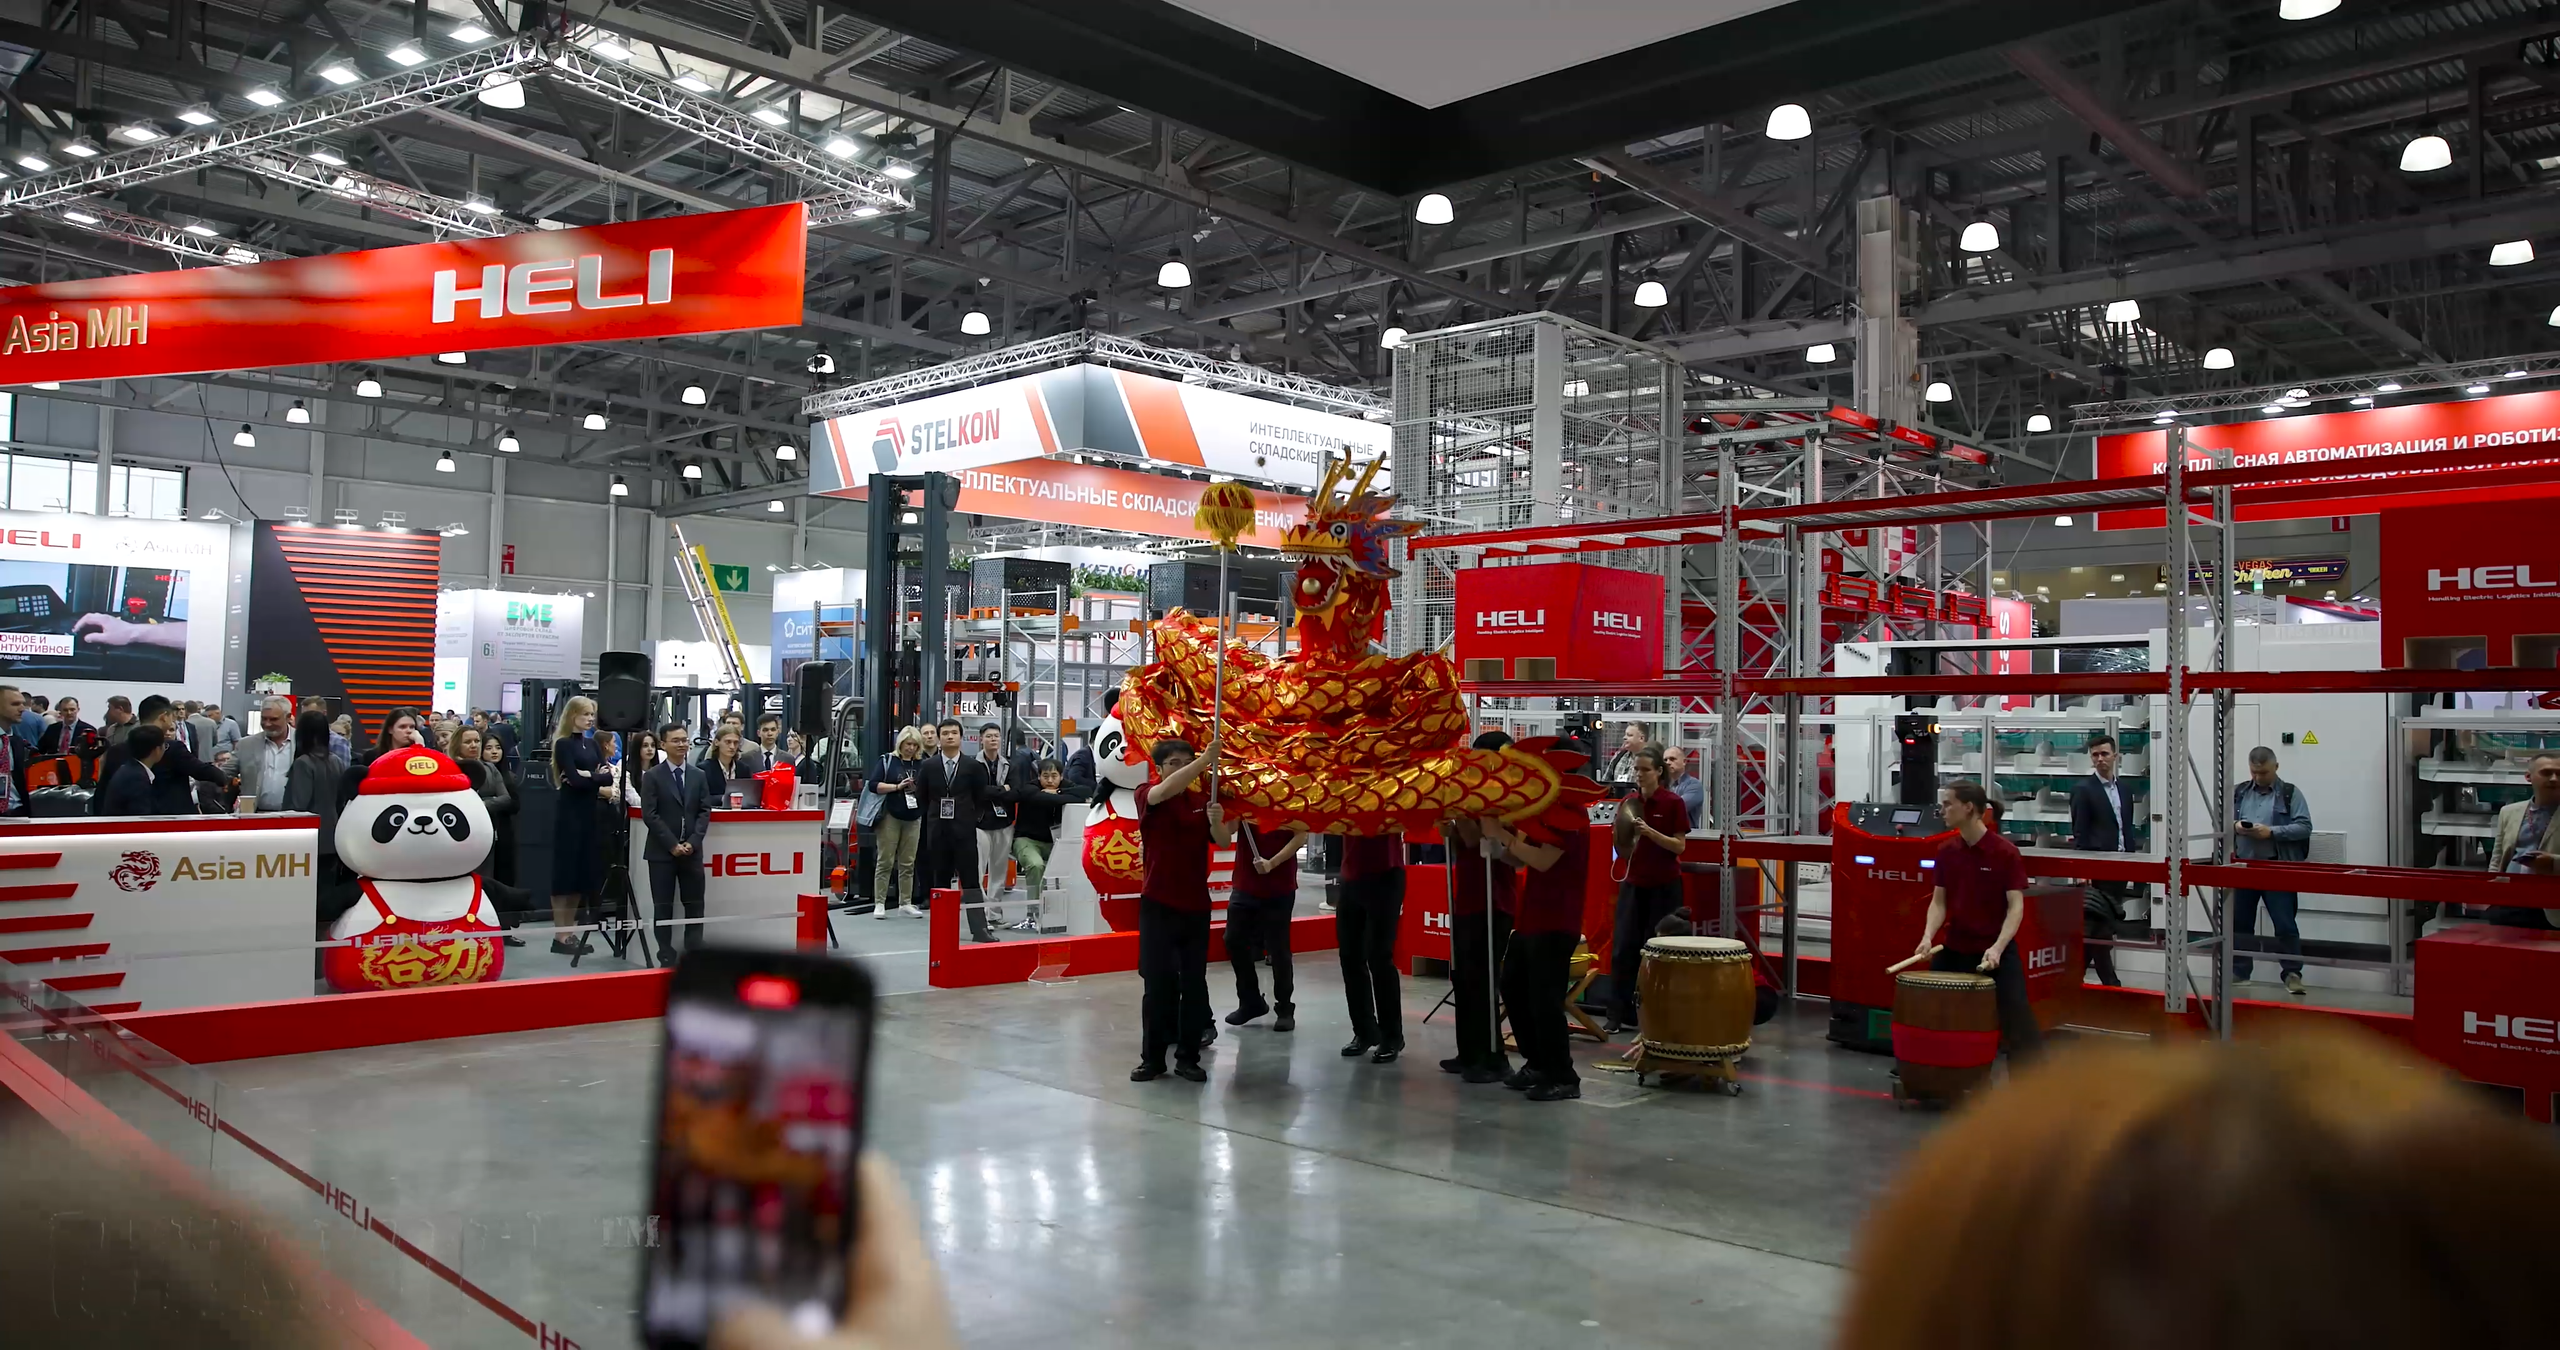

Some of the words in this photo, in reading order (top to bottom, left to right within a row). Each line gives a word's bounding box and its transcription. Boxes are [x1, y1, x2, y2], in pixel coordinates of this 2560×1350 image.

[432, 248, 673, 323] HELI
[2, 311, 79, 355] Asia
[86, 303, 149, 349] MH
[911, 407, 1000, 455] STELKON
[1249, 421, 1374, 456] ИНТЕЛЛЕКТУАЛЬНЫЕ
[1249, 440, 1318, 464] СКЛАДСКИЕ
[2152, 452, 2279, 475] КПЛСНАЯ
[2284, 437, 2448, 465] АВТОМАТИЗАЦИЯ
[2454, 435, 2468, 450] И
[2474, 427, 2560, 448] РОБОТИ
[1122, 491, 1197, 518] СКЛАДСК
[1255, 509, 1294, 529] ЕНИЯ
[155, 574, 183, 582] HELI
[2238, 560, 2274, 570] VEGAS
[2427, 564, 2560, 591] HEL
[506, 601, 554, 628] EME
[1476, 609, 1545, 628] HELI
[1593, 610, 1642, 631] HELI
[39, 635, 47, 644] И
[409, 761, 436, 770] HELI
[170, 855, 246, 882] Asia
[255, 852, 311, 879] MH
[1867, 868, 1924, 883] HELI
[1692, 918, 1721, 937] HE
[381, 929, 478, 982] 合力
[2028, 944, 2067, 970] HELI
[2463, 1010, 2560, 1043] HE
[187, 1096, 218, 1133] HELI
[326, 1180, 370, 1231] HELI
